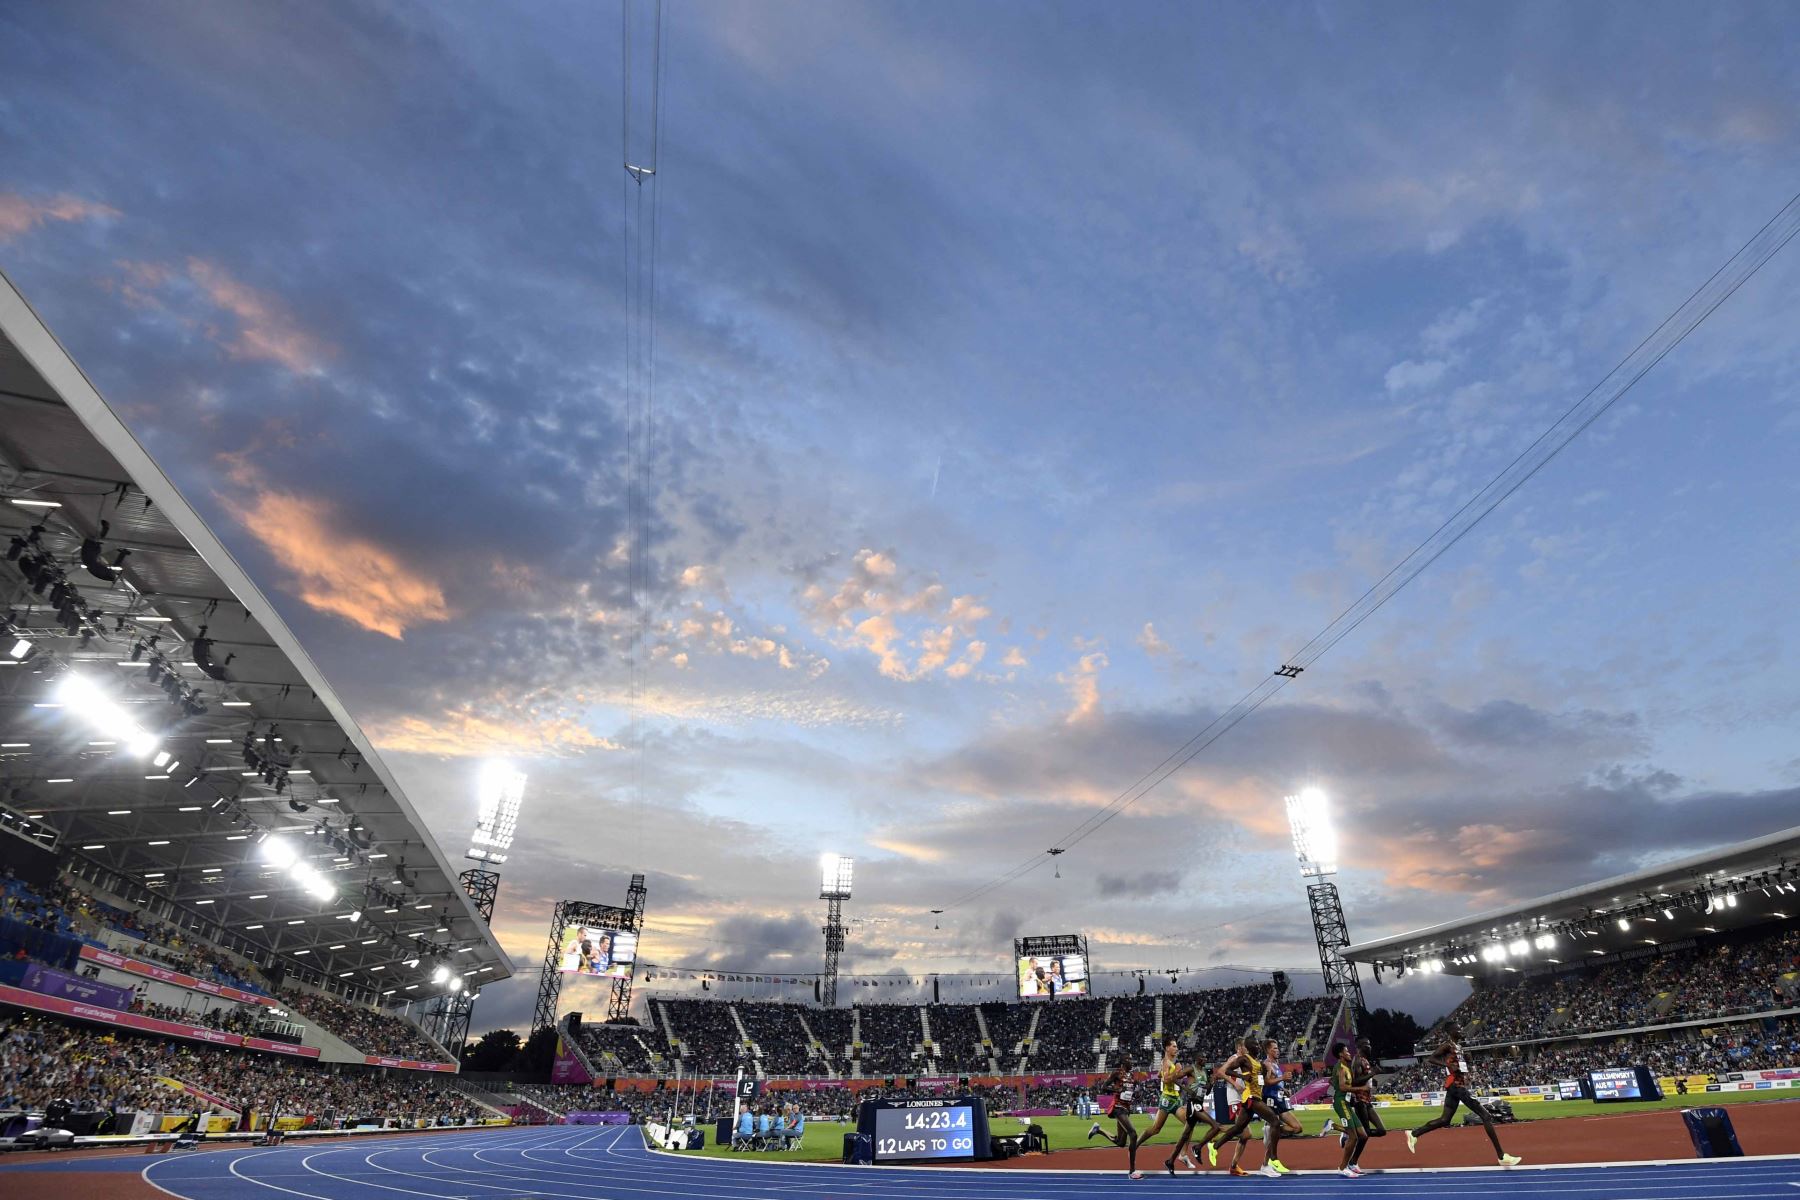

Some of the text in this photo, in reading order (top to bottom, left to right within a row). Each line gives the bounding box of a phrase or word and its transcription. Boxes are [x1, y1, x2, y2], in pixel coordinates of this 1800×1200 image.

[744, 1082, 753, 1094] 12
[905, 1111, 966, 1129] 14:23.4
[878, 1137, 972, 1154] 12 LAPS TO GO
